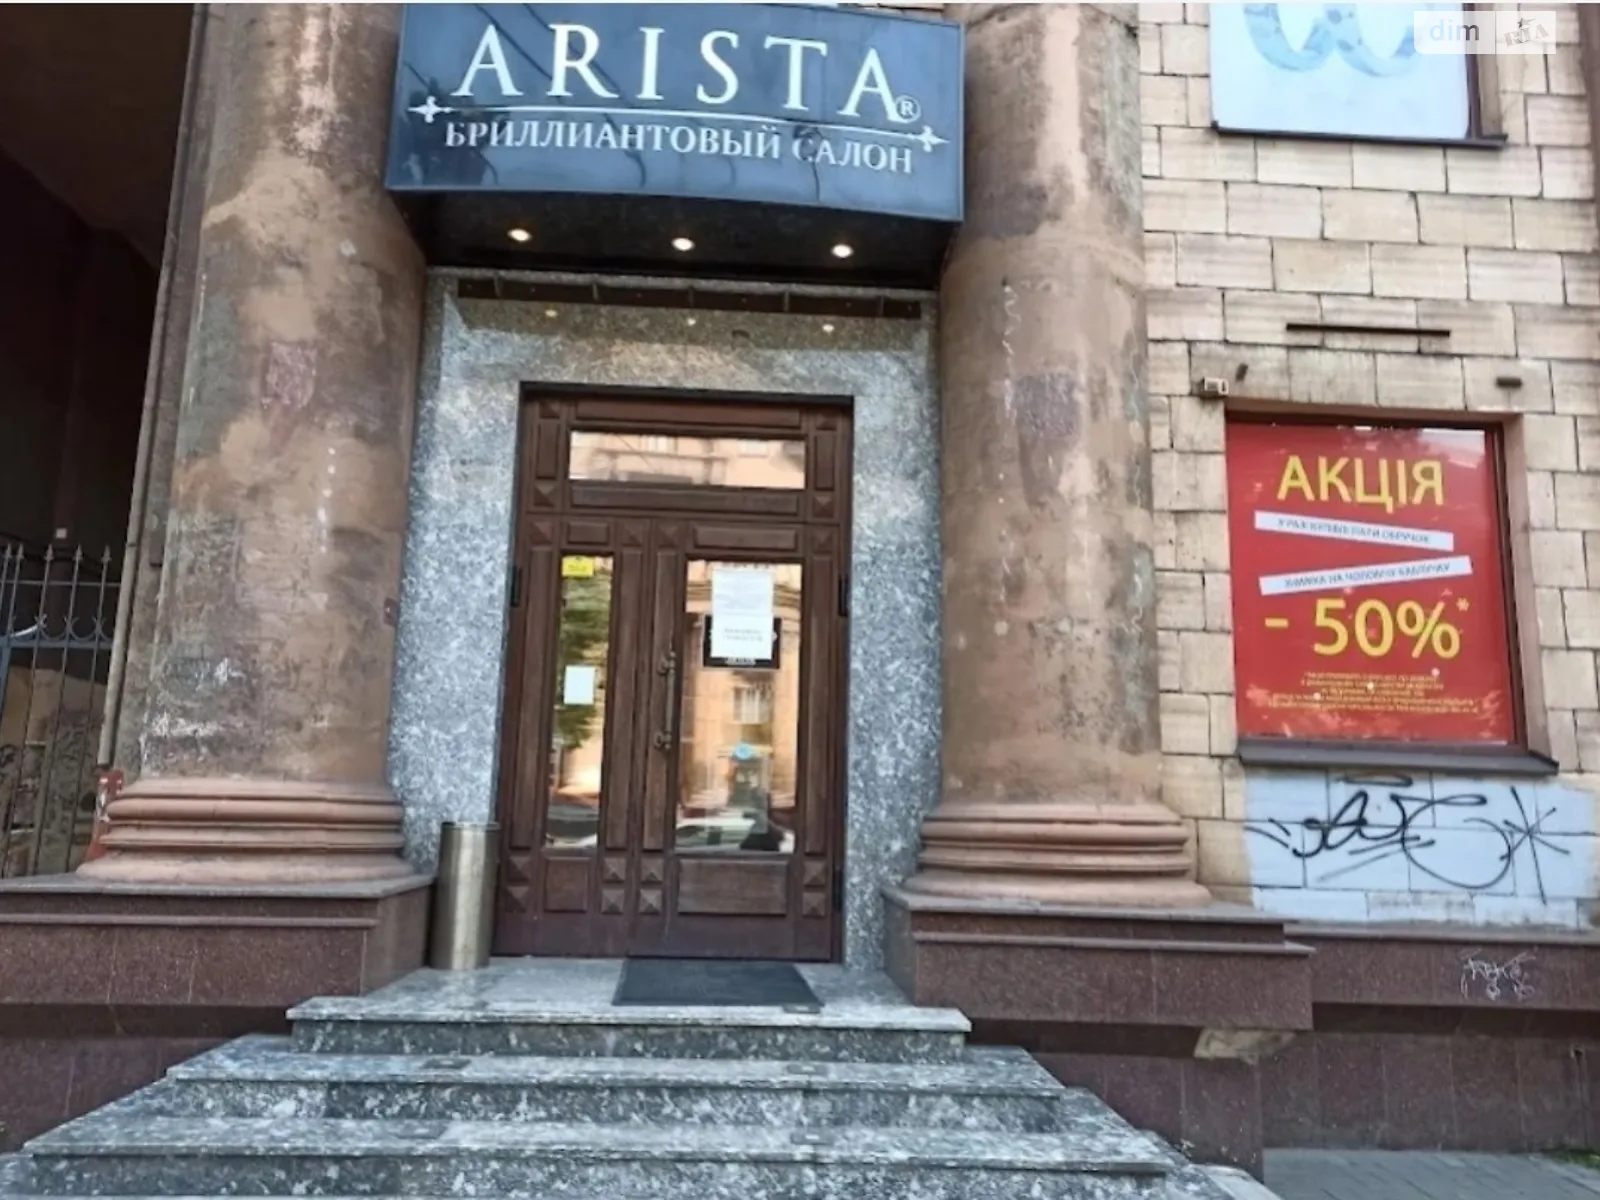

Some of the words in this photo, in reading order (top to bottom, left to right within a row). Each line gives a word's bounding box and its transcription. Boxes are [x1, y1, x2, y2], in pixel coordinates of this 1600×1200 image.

[445, 122, 781, 160] БРИЛЛИАНТОВЫЙ
[792, 137, 914, 174] САЛОН
[1276, 455, 1445, 514] АКЦІЯ
